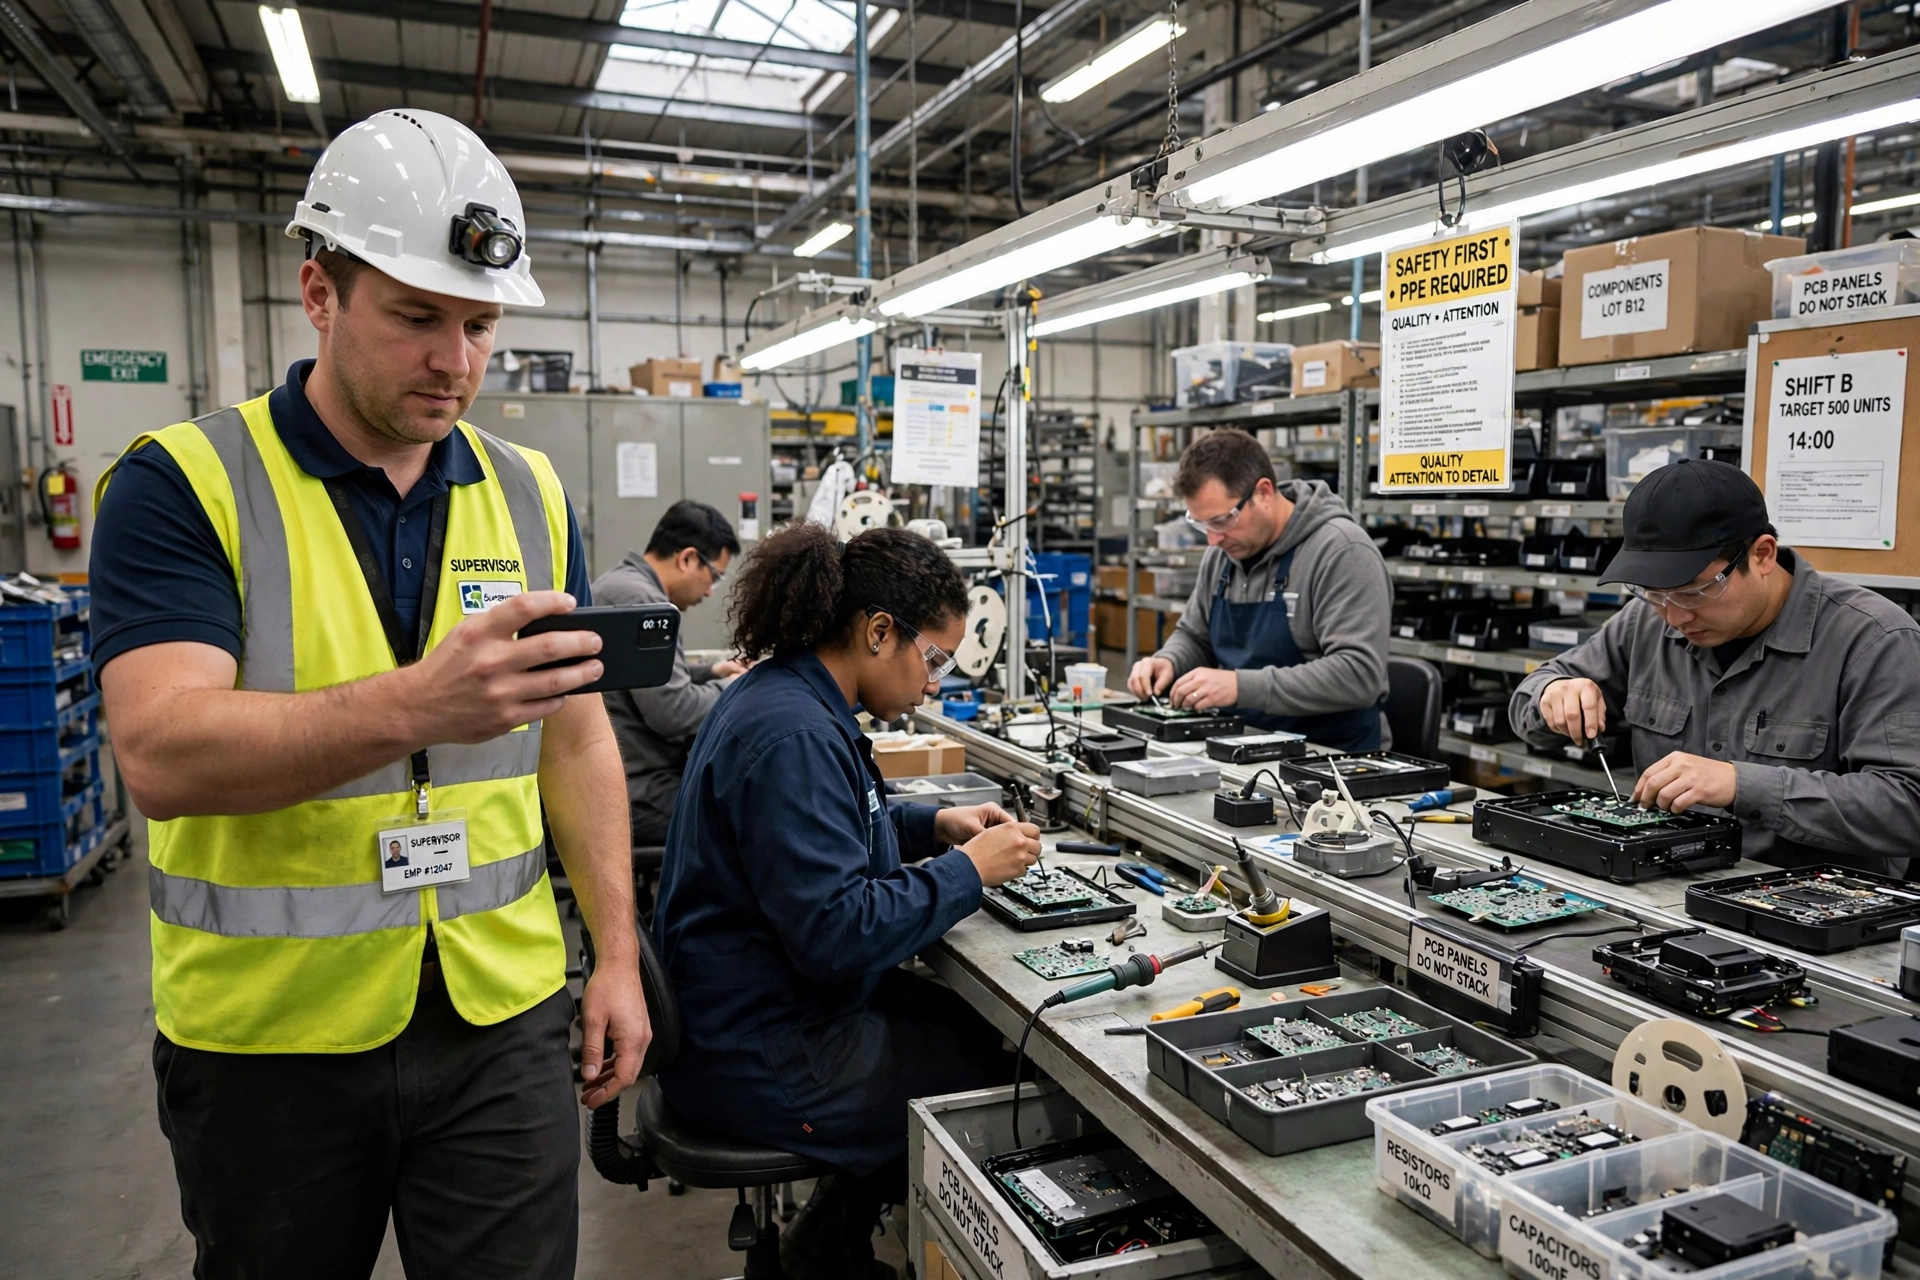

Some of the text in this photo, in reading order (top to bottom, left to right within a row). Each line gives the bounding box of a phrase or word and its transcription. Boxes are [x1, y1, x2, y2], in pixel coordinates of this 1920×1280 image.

[1395, 236, 1499, 278] SAFETY FIRST
[1400, 264, 1508, 303] PPE REQUIRED
[1588, 273, 1663, 299] COMPONENTS
[1804, 272, 1883, 296] PCB PANELS
[1602, 298, 1645, 318] LOT B12
[1799, 290, 1887, 315] DO NOT STACK
[1392, 301, 1499, 331] QUALITY ATTENTION
[84, 352, 163, 368] EMERGENCY
[112, 368, 138, 381] EXIT
[1784, 374, 1853, 397] SHIFT B
[1780, 396, 1891, 417] TARGET 500 UNITS
[1788, 430, 1834, 450] 14:00
[1420, 454, 1464, 469] QUALITY
[1389, 469, 1499, 485] ATTENTION TO DETAIL
[450, 558, 520, 573] SUPERVISOR
[410, 832, 460, 848] SUPERVISOR
[404, 862, 452, 879] EMP #12047
[1424, 937, 1488, 976] PCB PANELS
[1417, 952, 1490, 998] DO NOT STACK
[1386, 1140, 1450, 1190] RESISTORS
[1403, 1172, 1432, 1200] 10kΩ
[942, 1161, 998, 1245] PCB PANELS
[939, 1182, 1004, 1280] DO NOT STACK
[1510, 1214, 1601, 1280] CAPACITORS
[1528, 1249, 1569, 1280] 100nF
